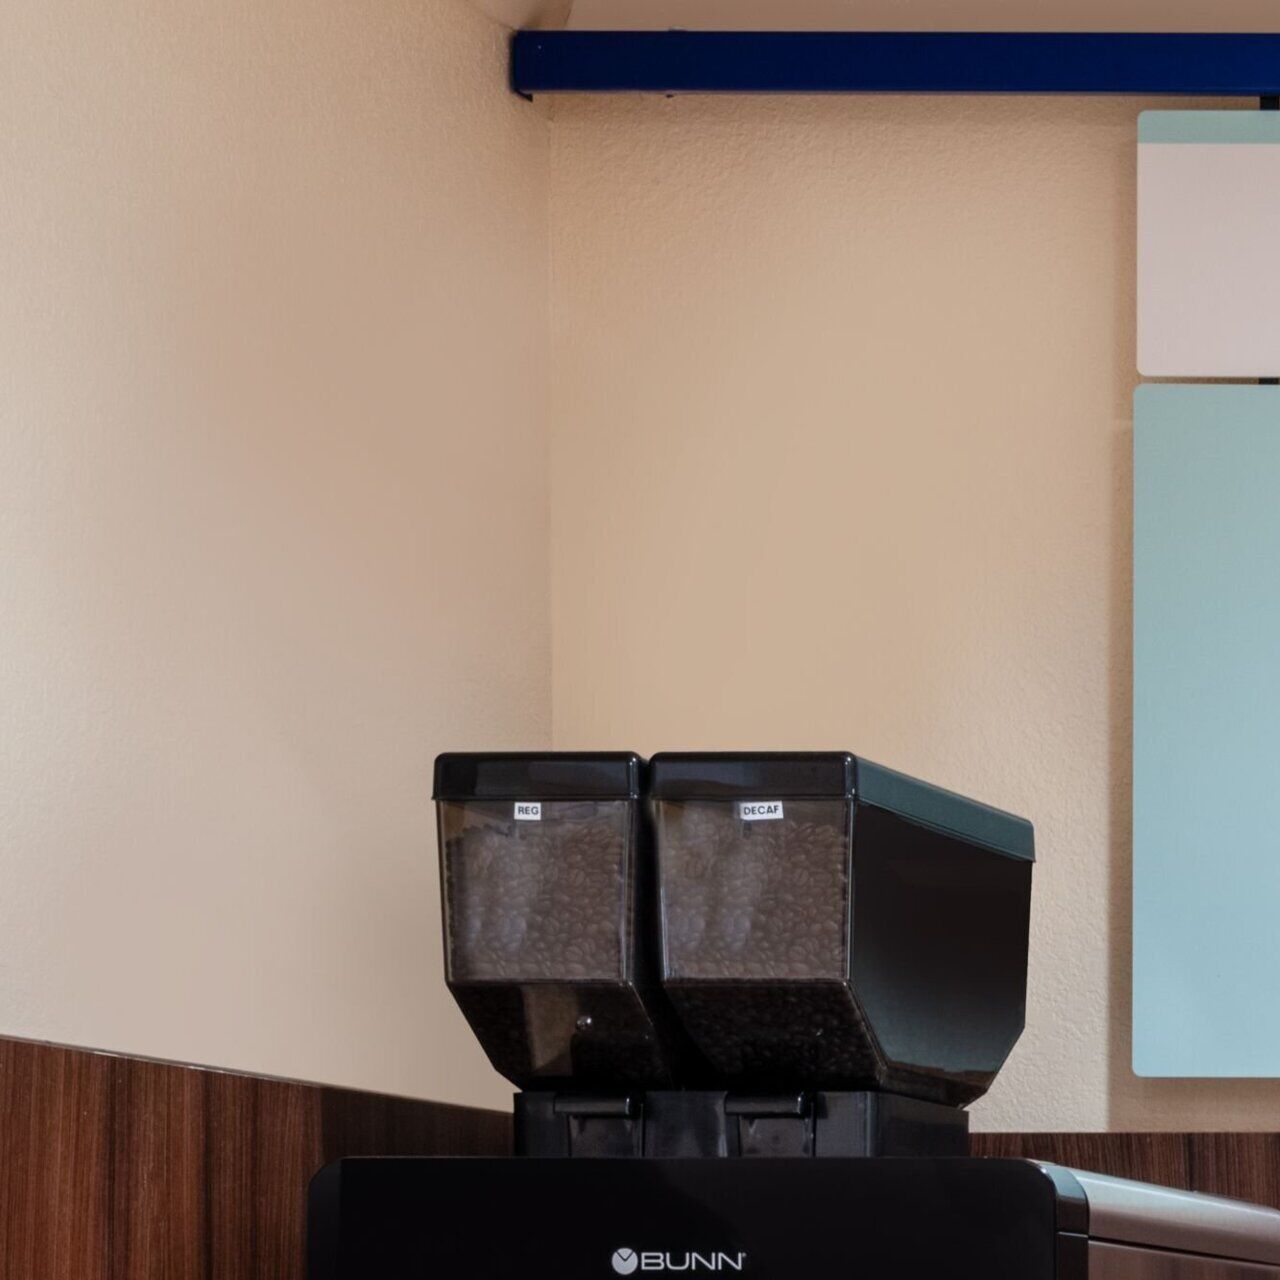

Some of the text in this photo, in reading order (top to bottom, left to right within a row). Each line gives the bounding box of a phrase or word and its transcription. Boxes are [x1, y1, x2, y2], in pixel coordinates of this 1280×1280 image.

[517, 805, 540, 816] REG
[743, 804, 781, 816] DECAF
[640, 1251, 743, 1271] BUNN
